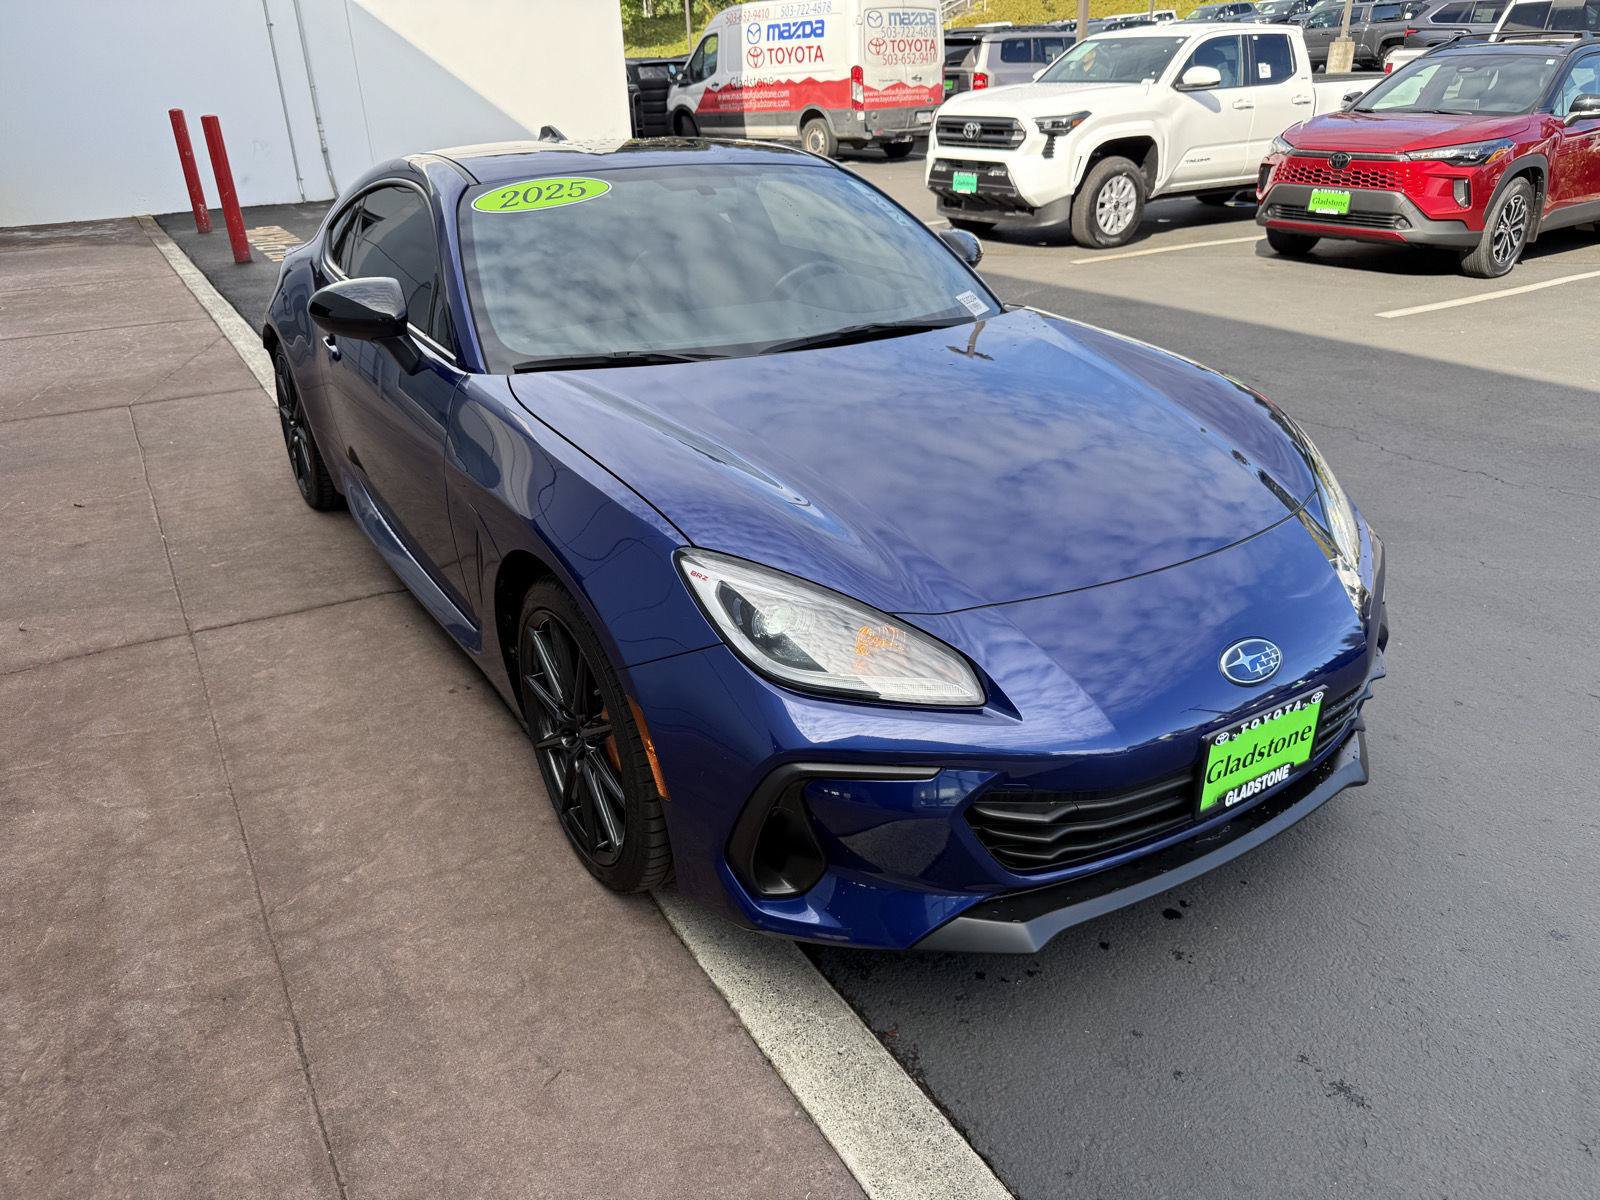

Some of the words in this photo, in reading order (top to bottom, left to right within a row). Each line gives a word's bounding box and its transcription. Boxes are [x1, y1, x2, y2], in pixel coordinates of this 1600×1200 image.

[881, 25, 937, 38] 503-722-4878
[889, 39, 936, 53] TOYOTA
[767, 45, 824, 64] TOYOTA
[882, 52, 938, 65] 503-652-9410
[730, 76, 774, 90] Gladstone
[500, 181, 587, 208] 2025
[1312, 197, 1347, 207] Gladstone
[690, 570, 709, 581] BRZ
[1240, 700, 1302, 733] TOYOTA
[1206, 725, 1312, 785] Gladstone
[1225, 764, 1291, 807] GLADSTONE
